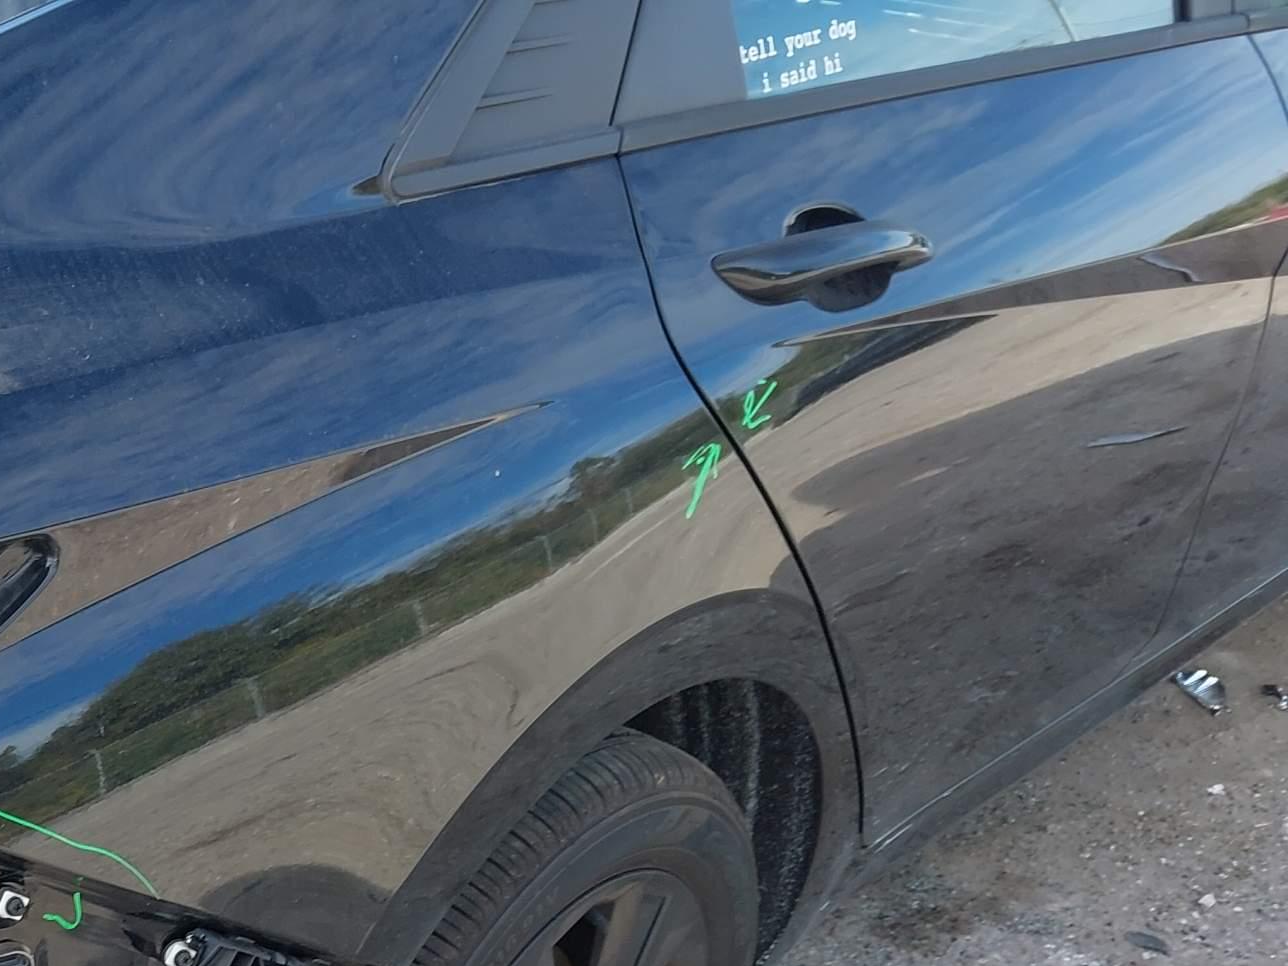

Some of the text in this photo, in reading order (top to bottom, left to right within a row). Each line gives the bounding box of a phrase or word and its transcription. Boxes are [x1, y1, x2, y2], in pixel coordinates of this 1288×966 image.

[739, 19, 857, 64] tell your dog
[762, 52, 843, 93] i said hi
